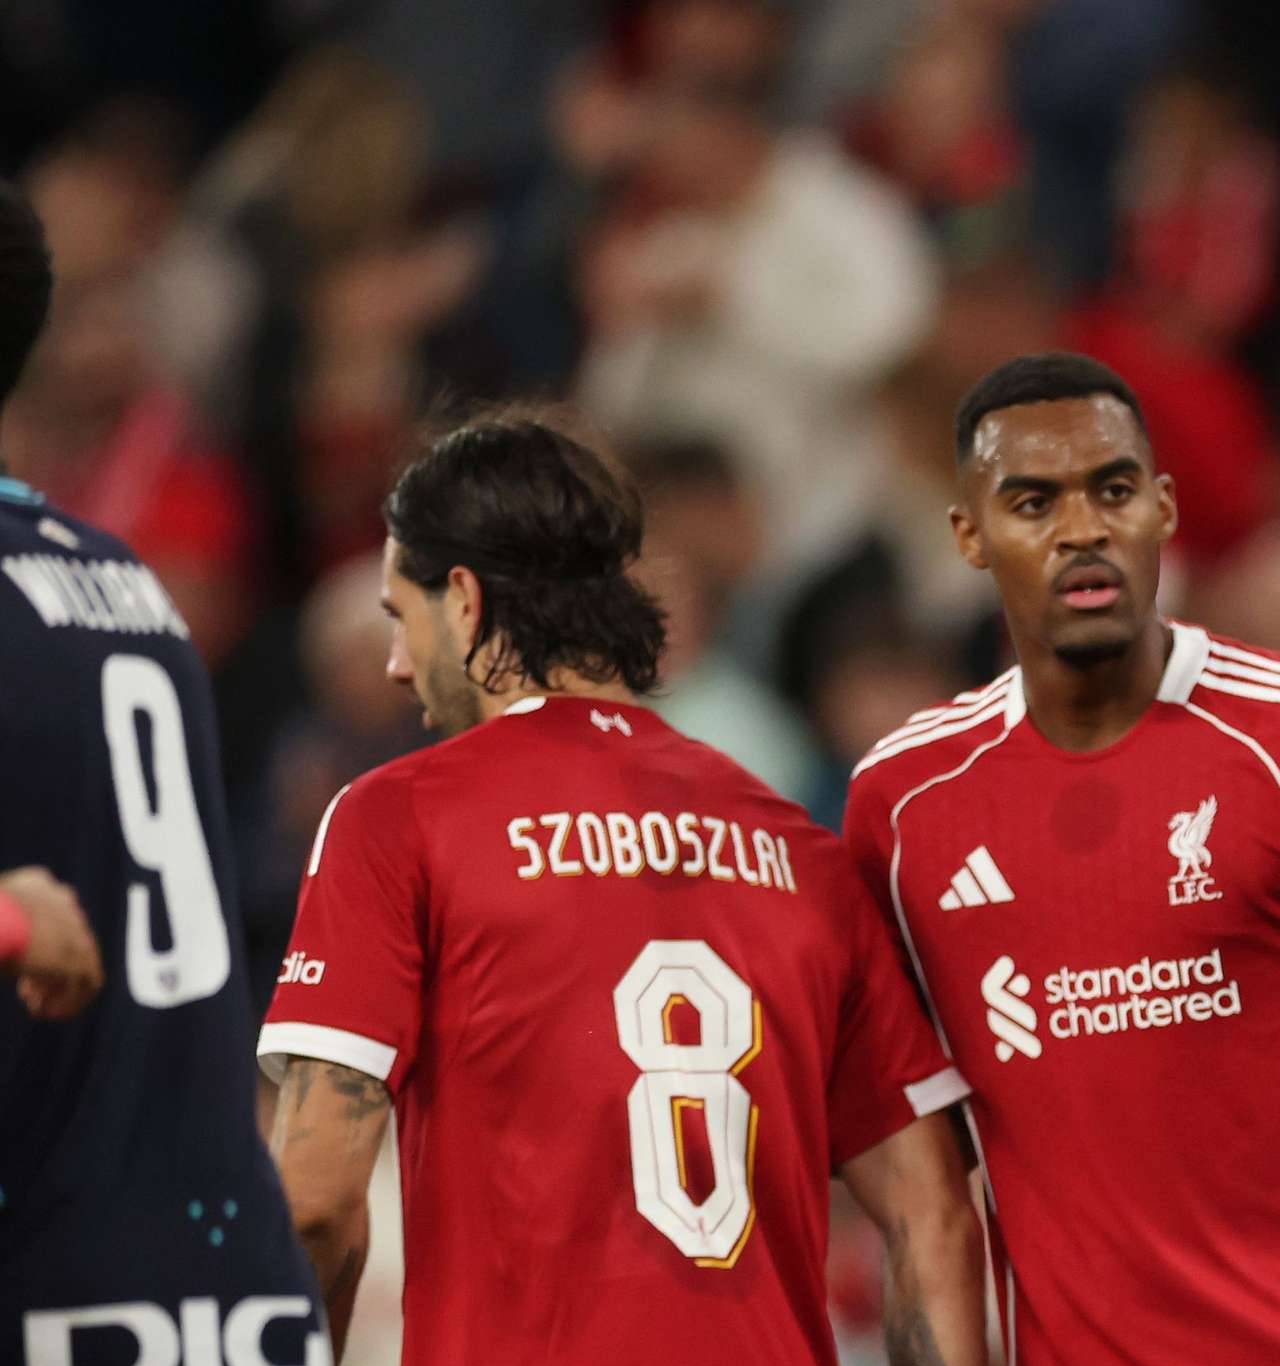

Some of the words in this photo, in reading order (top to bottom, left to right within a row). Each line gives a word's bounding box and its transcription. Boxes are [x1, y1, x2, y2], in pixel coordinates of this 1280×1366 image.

[101, 653, 232, 1009] 9
[507, 811, 798, 895] SZOBOSZLAI
[1044, 948, 1225, 1004] standard
[1048, 982, 1242, 1039] chartered
[613, 939, 762, 1270] 8
